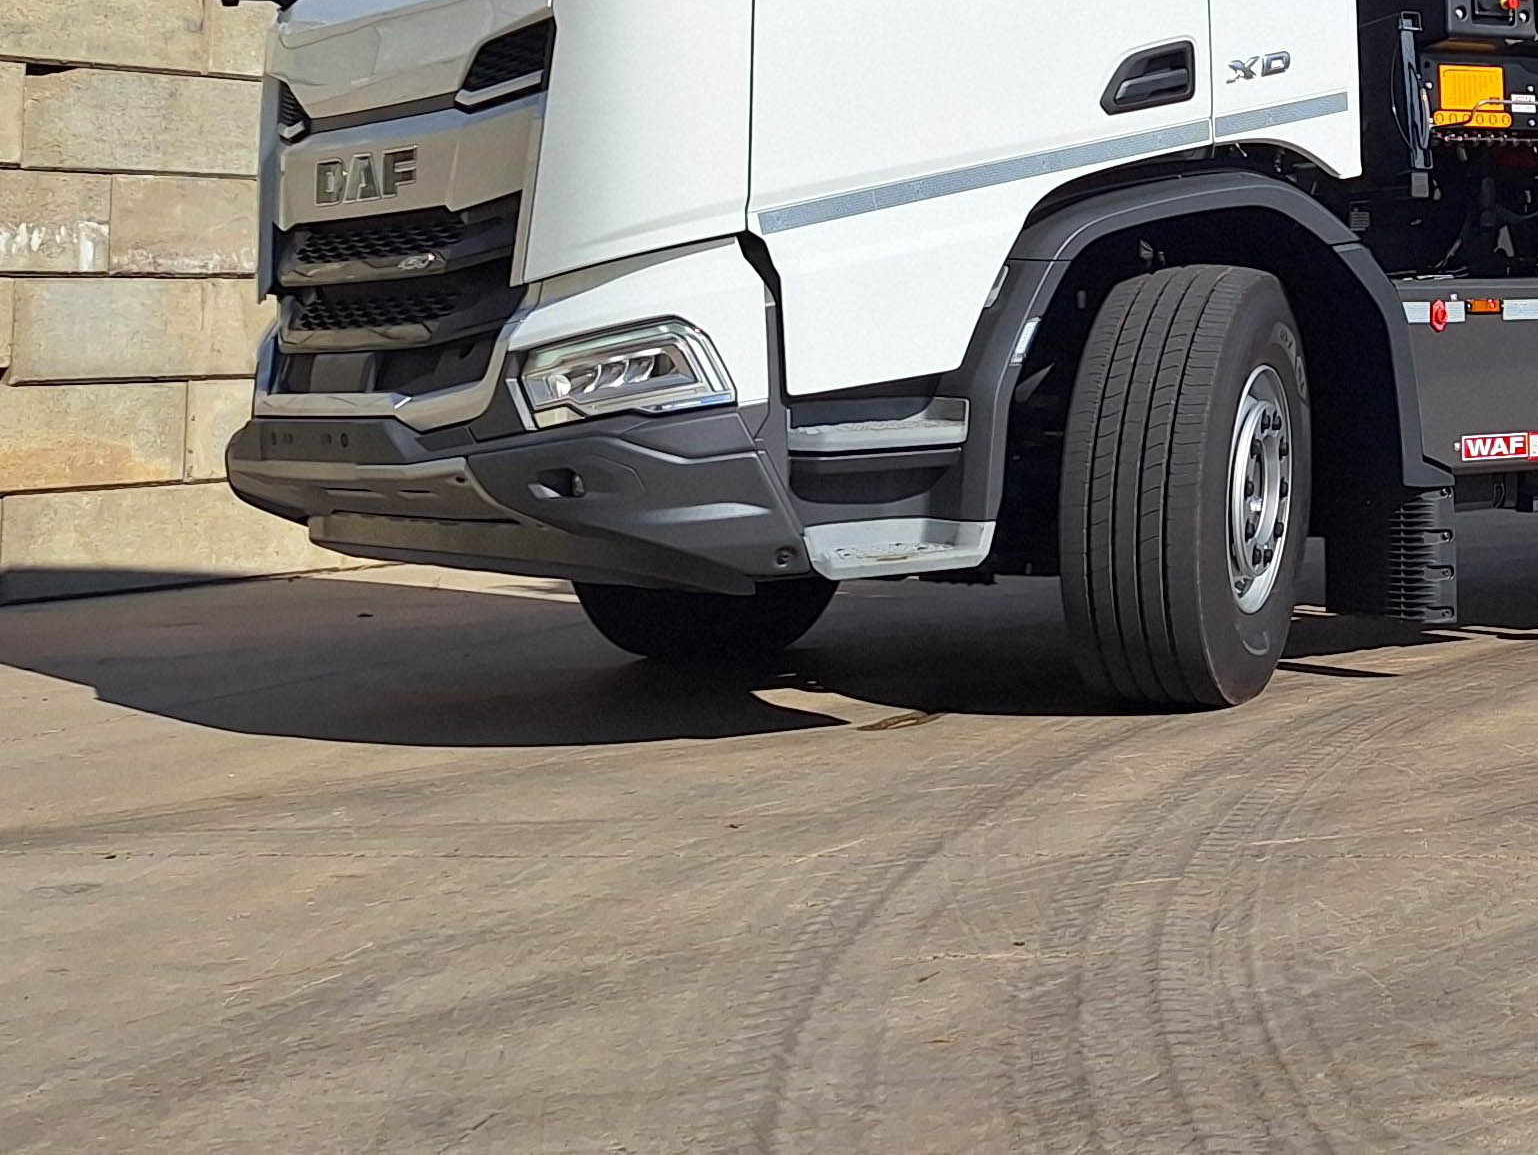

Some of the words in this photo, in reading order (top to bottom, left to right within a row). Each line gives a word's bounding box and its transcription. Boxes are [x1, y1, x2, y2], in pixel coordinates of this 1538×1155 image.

[1225, 50, 1291, 85] XD
[313, 144, 419, 207] DAF
[1465, 436, 1525, 457] WAF
